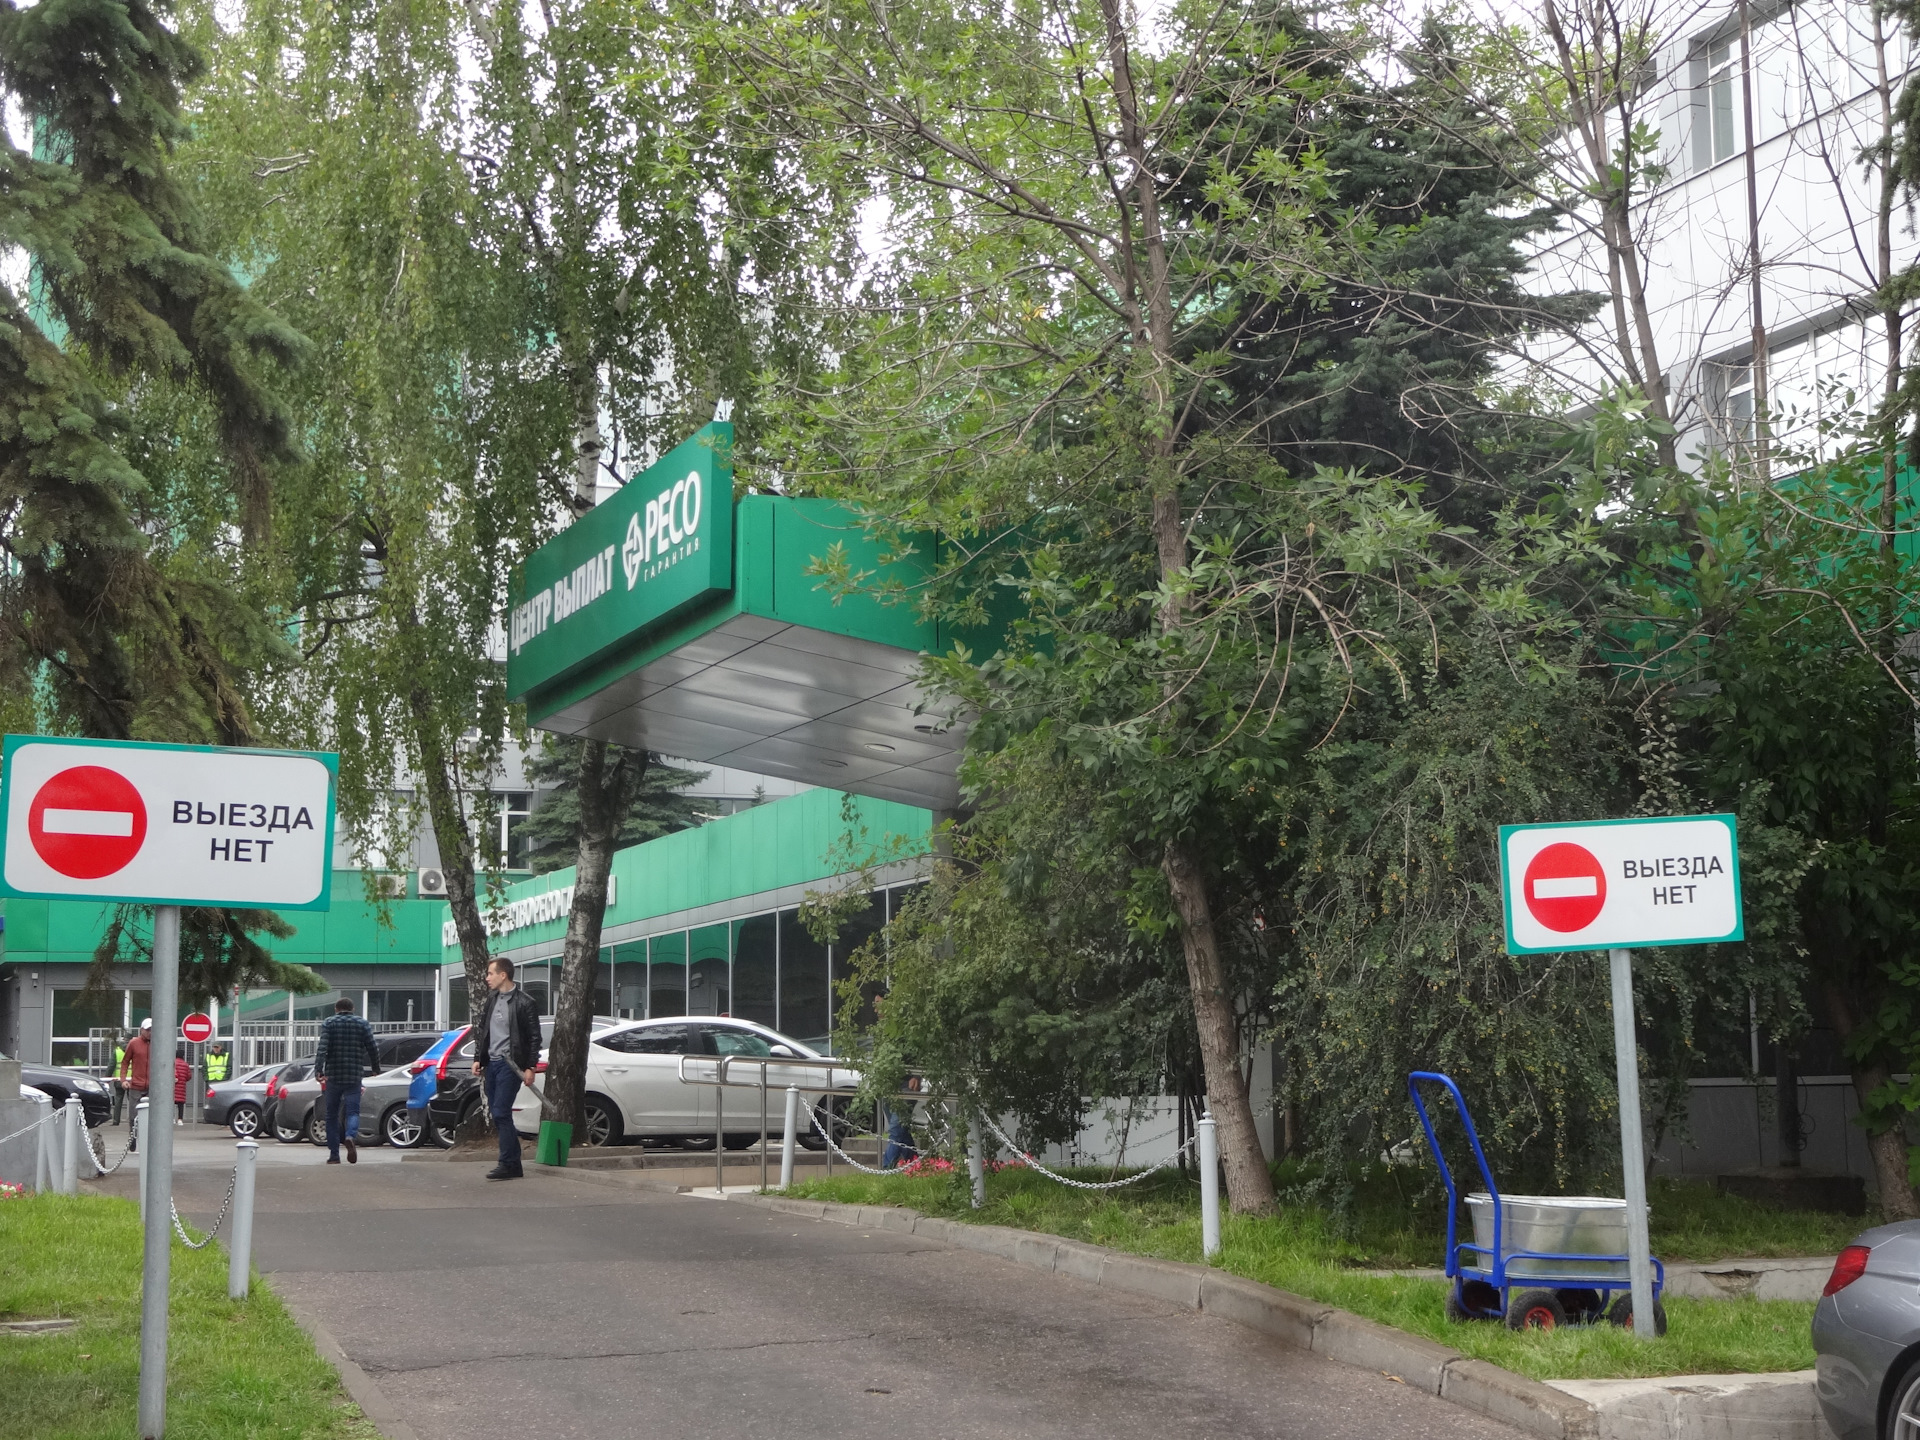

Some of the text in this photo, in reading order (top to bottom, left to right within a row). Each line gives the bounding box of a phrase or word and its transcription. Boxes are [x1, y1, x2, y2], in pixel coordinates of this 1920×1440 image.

[511, 471, 701, 657] ЦЕНТР ВЫПЛАТ РЕСО
[644, 537, 699, 582] ГАРАНТИЯ
[173, 800, 314, 833] ВЫЕЗДА
[210, 838, 274, 863] НЕТ
[1623, 856, 1724, 879] ВЫЕЗДА
[1653, 885, 1697, 905] НЕТ
